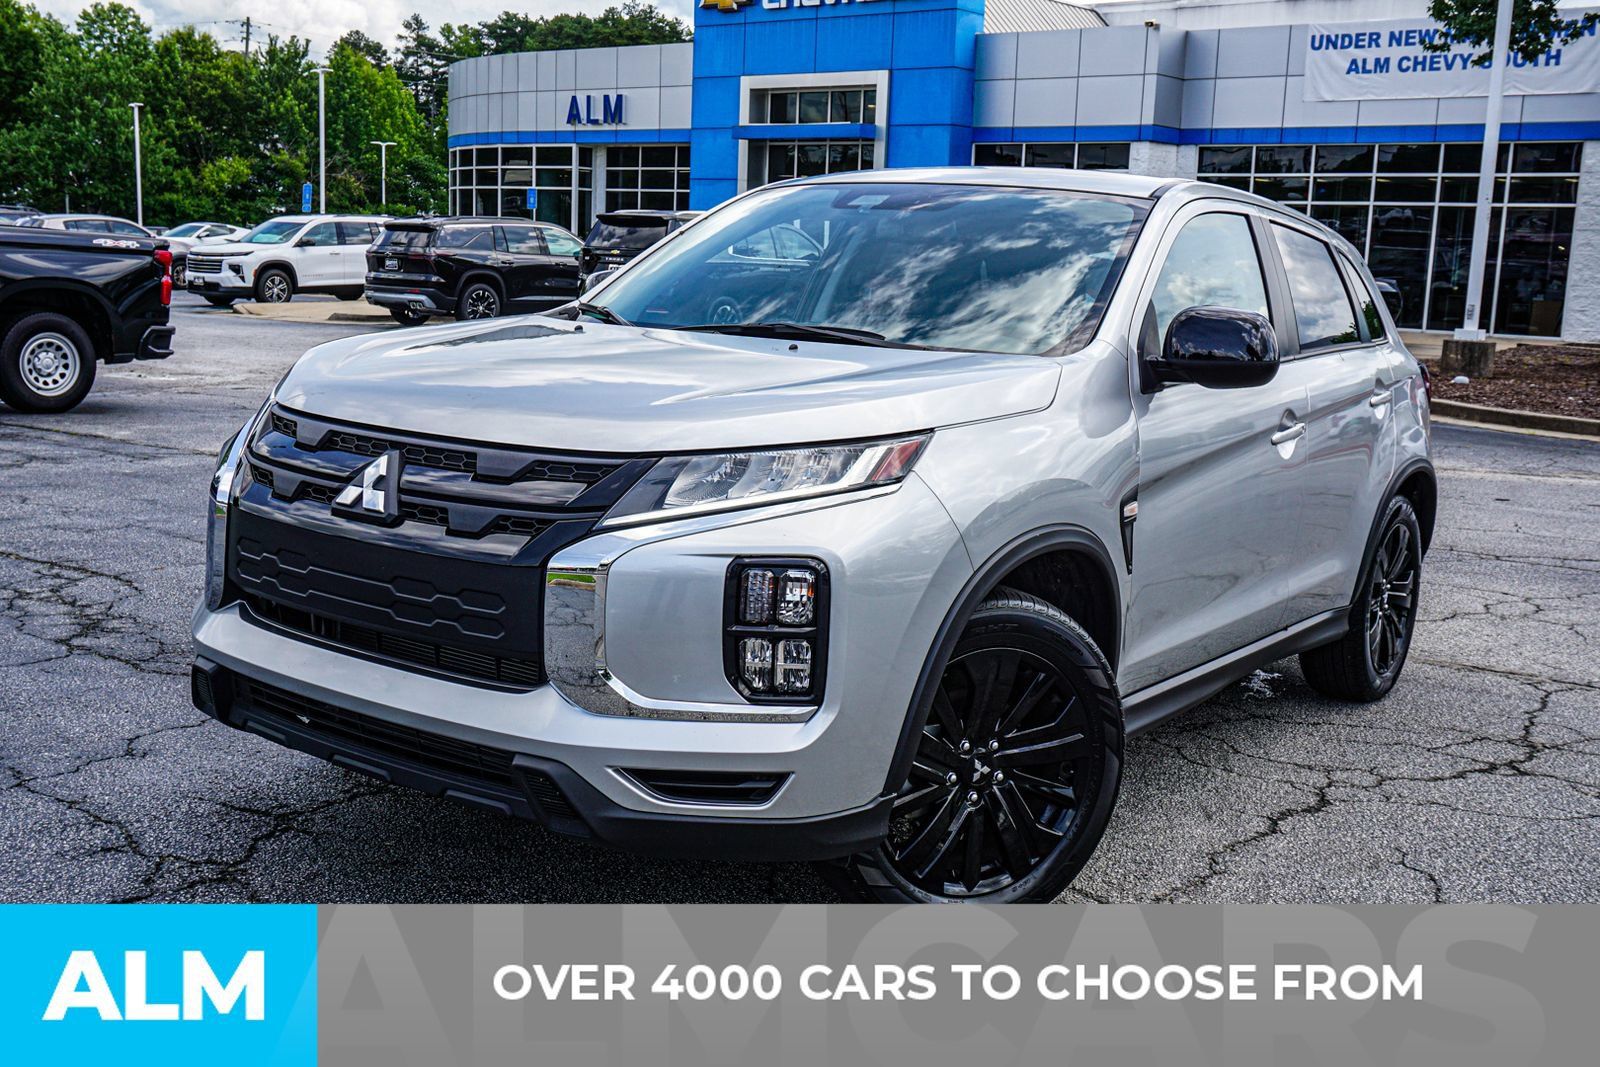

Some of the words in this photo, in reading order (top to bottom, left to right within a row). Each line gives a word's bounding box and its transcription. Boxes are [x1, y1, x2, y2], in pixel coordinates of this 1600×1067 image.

[1310, 31, 1382, 51] UNDER
[1388, 28, 1439, 48] NEW
[1345, 56, 1391, 75] ALM
[1397, 53, 1474, 73] CHEVY
[566, 94, 625, 126] ALM
